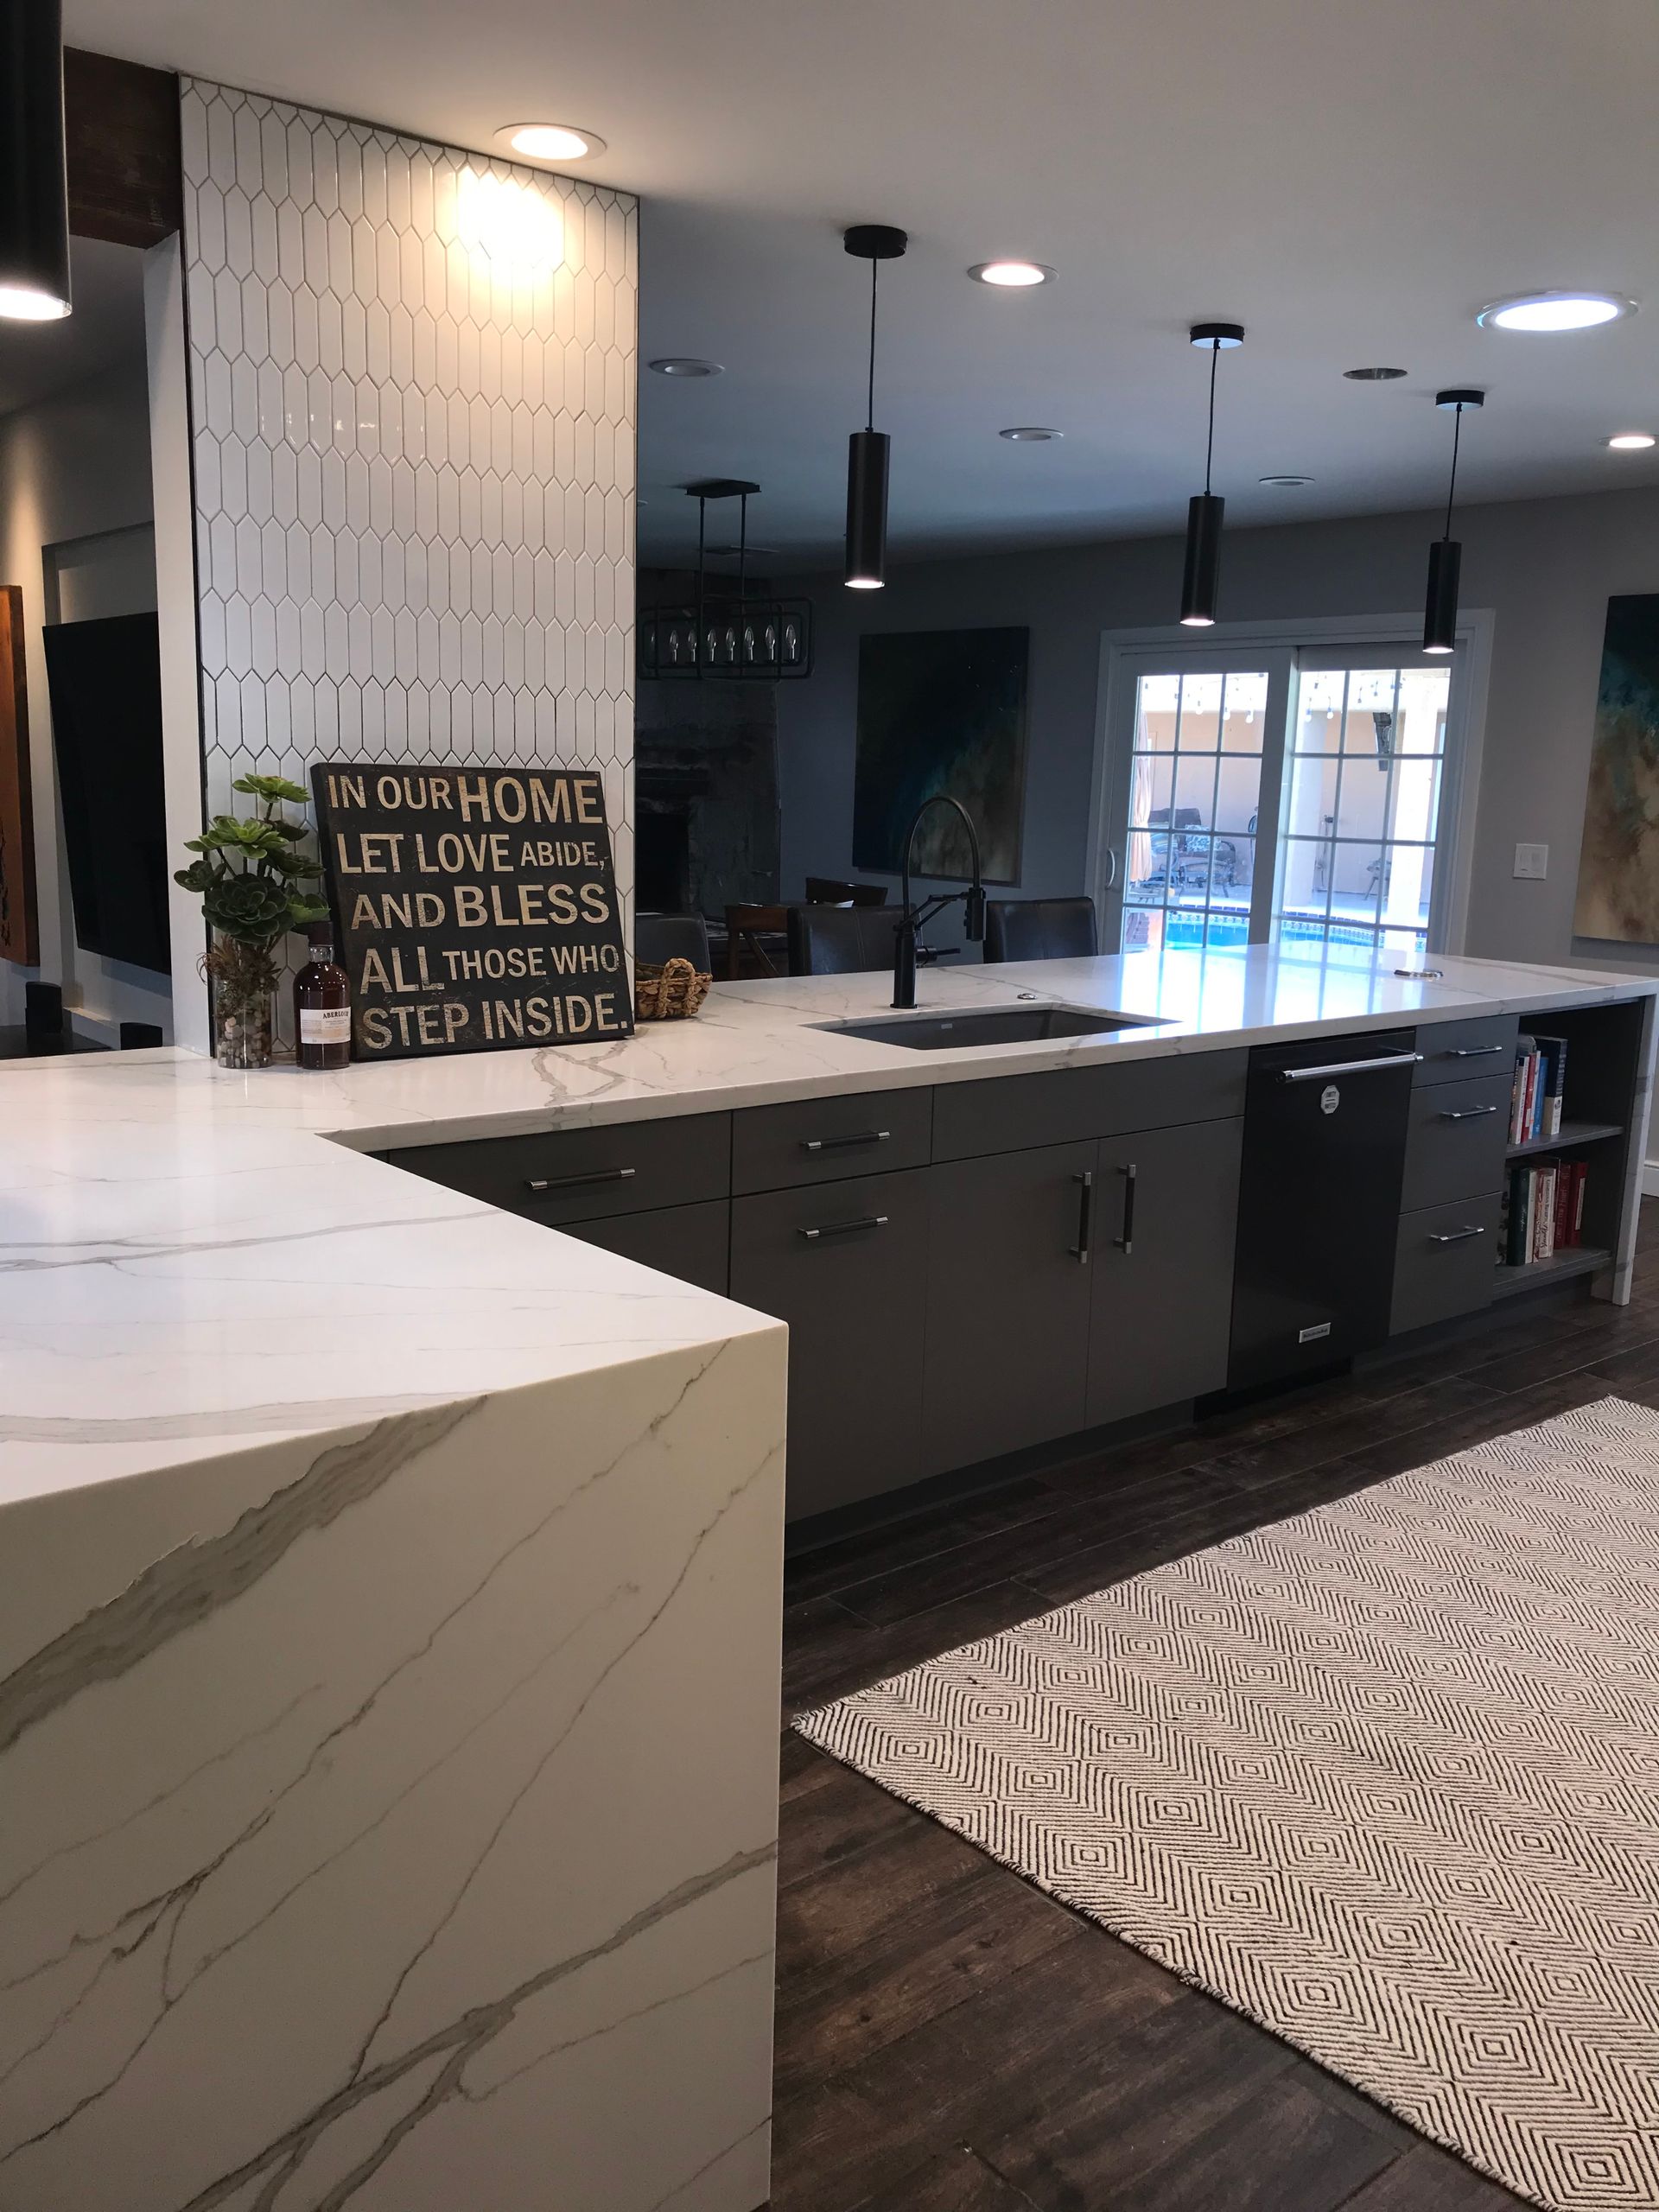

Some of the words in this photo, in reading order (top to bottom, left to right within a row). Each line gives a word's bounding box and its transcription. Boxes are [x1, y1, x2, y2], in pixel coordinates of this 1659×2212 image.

[327, 775, 366, 808] IN
[377, 776, 454, 810] OUR
[457, 776, 603, 823] HOME
[336, 833, 404, 874] LET
[415, 833, 514, 873] LOVE
[520, 842, 605, 871] ABIDE,
[351, 893, 446, 930] AND
[454, 883, 610, 927] BLESS
[359, 946, 445, 995] ALL
[442, 947, 547, 981] THOSE
[550, 944, 620, 976] WHO
[362, 1002, 469, 1049] STEP
[481, 993, 628, 1040] INSIDE.
